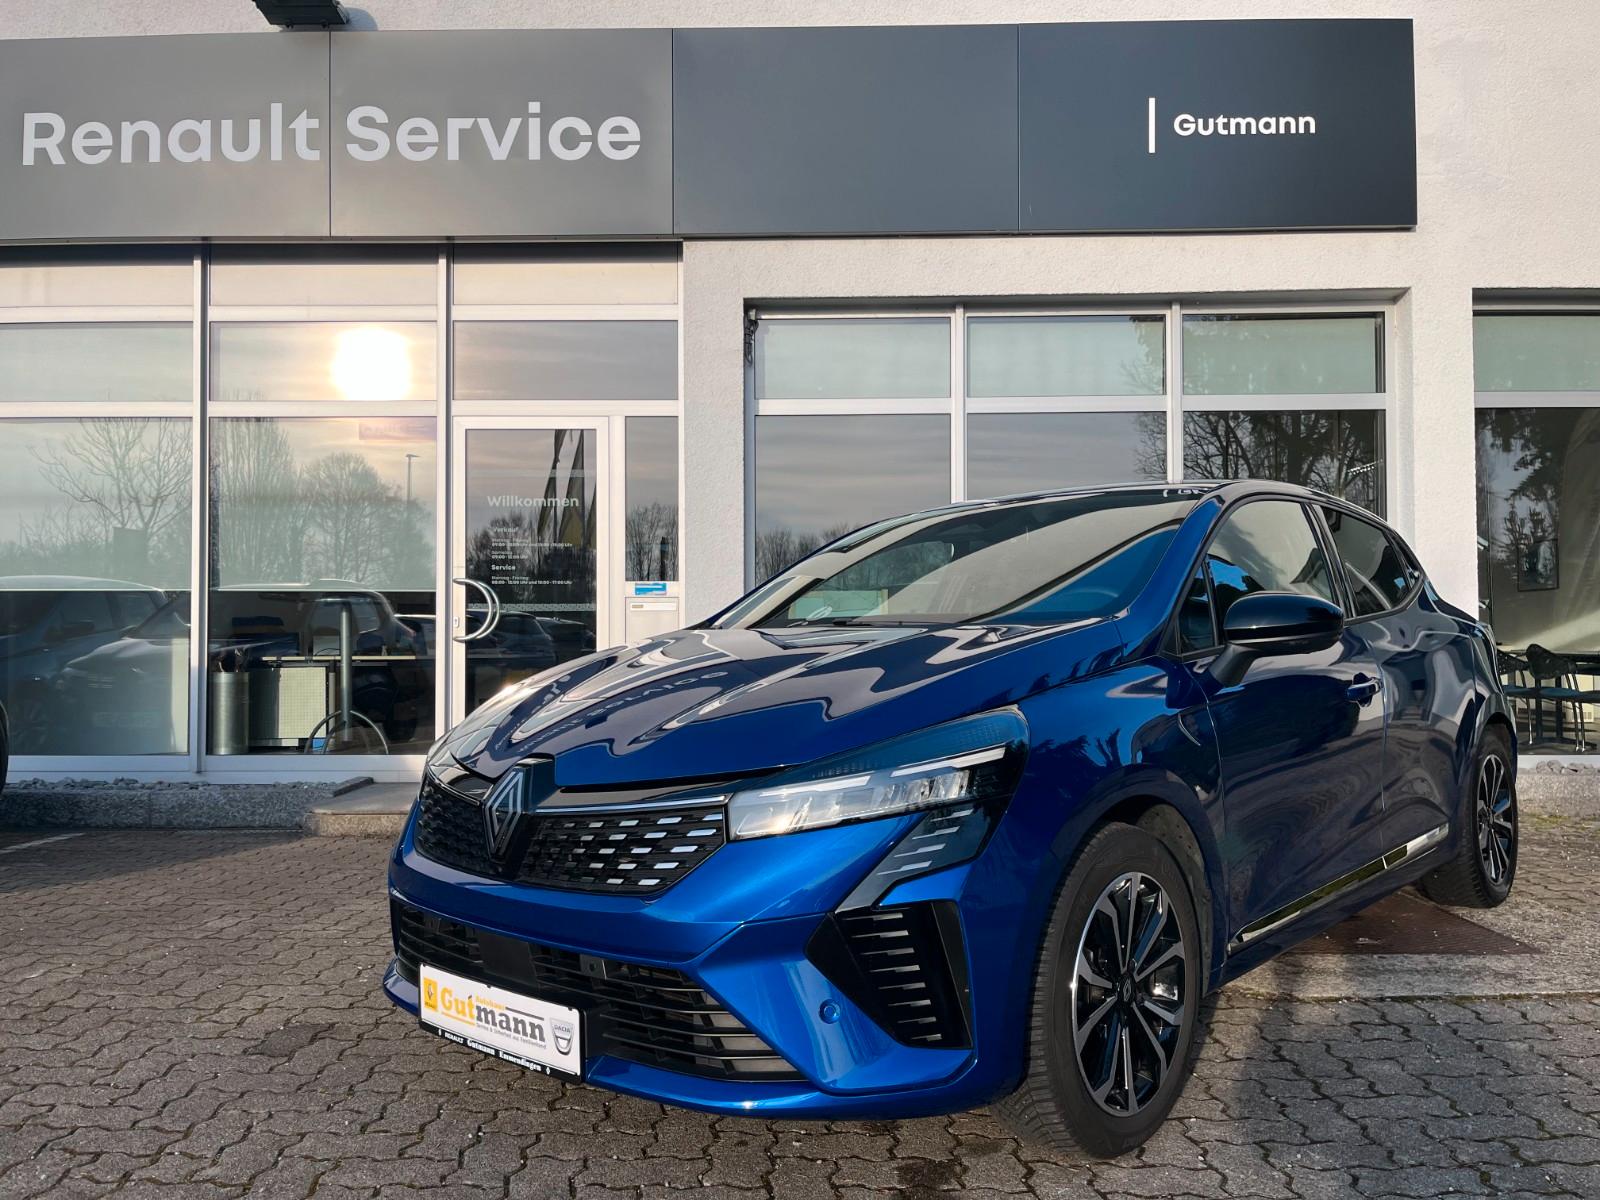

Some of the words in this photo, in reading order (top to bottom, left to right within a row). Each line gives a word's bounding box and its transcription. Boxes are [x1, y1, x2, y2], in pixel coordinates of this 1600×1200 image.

[22, 103, 321, 165] Renault
[345, 101, 642, 163] Service
[1173, 113, 1316, 136] Gutmann
[487, 496, 579, 507] Willkommen
[440, 986, 546, 1043] Gutmann
[554, 1023, 571, 1034] DACIA
